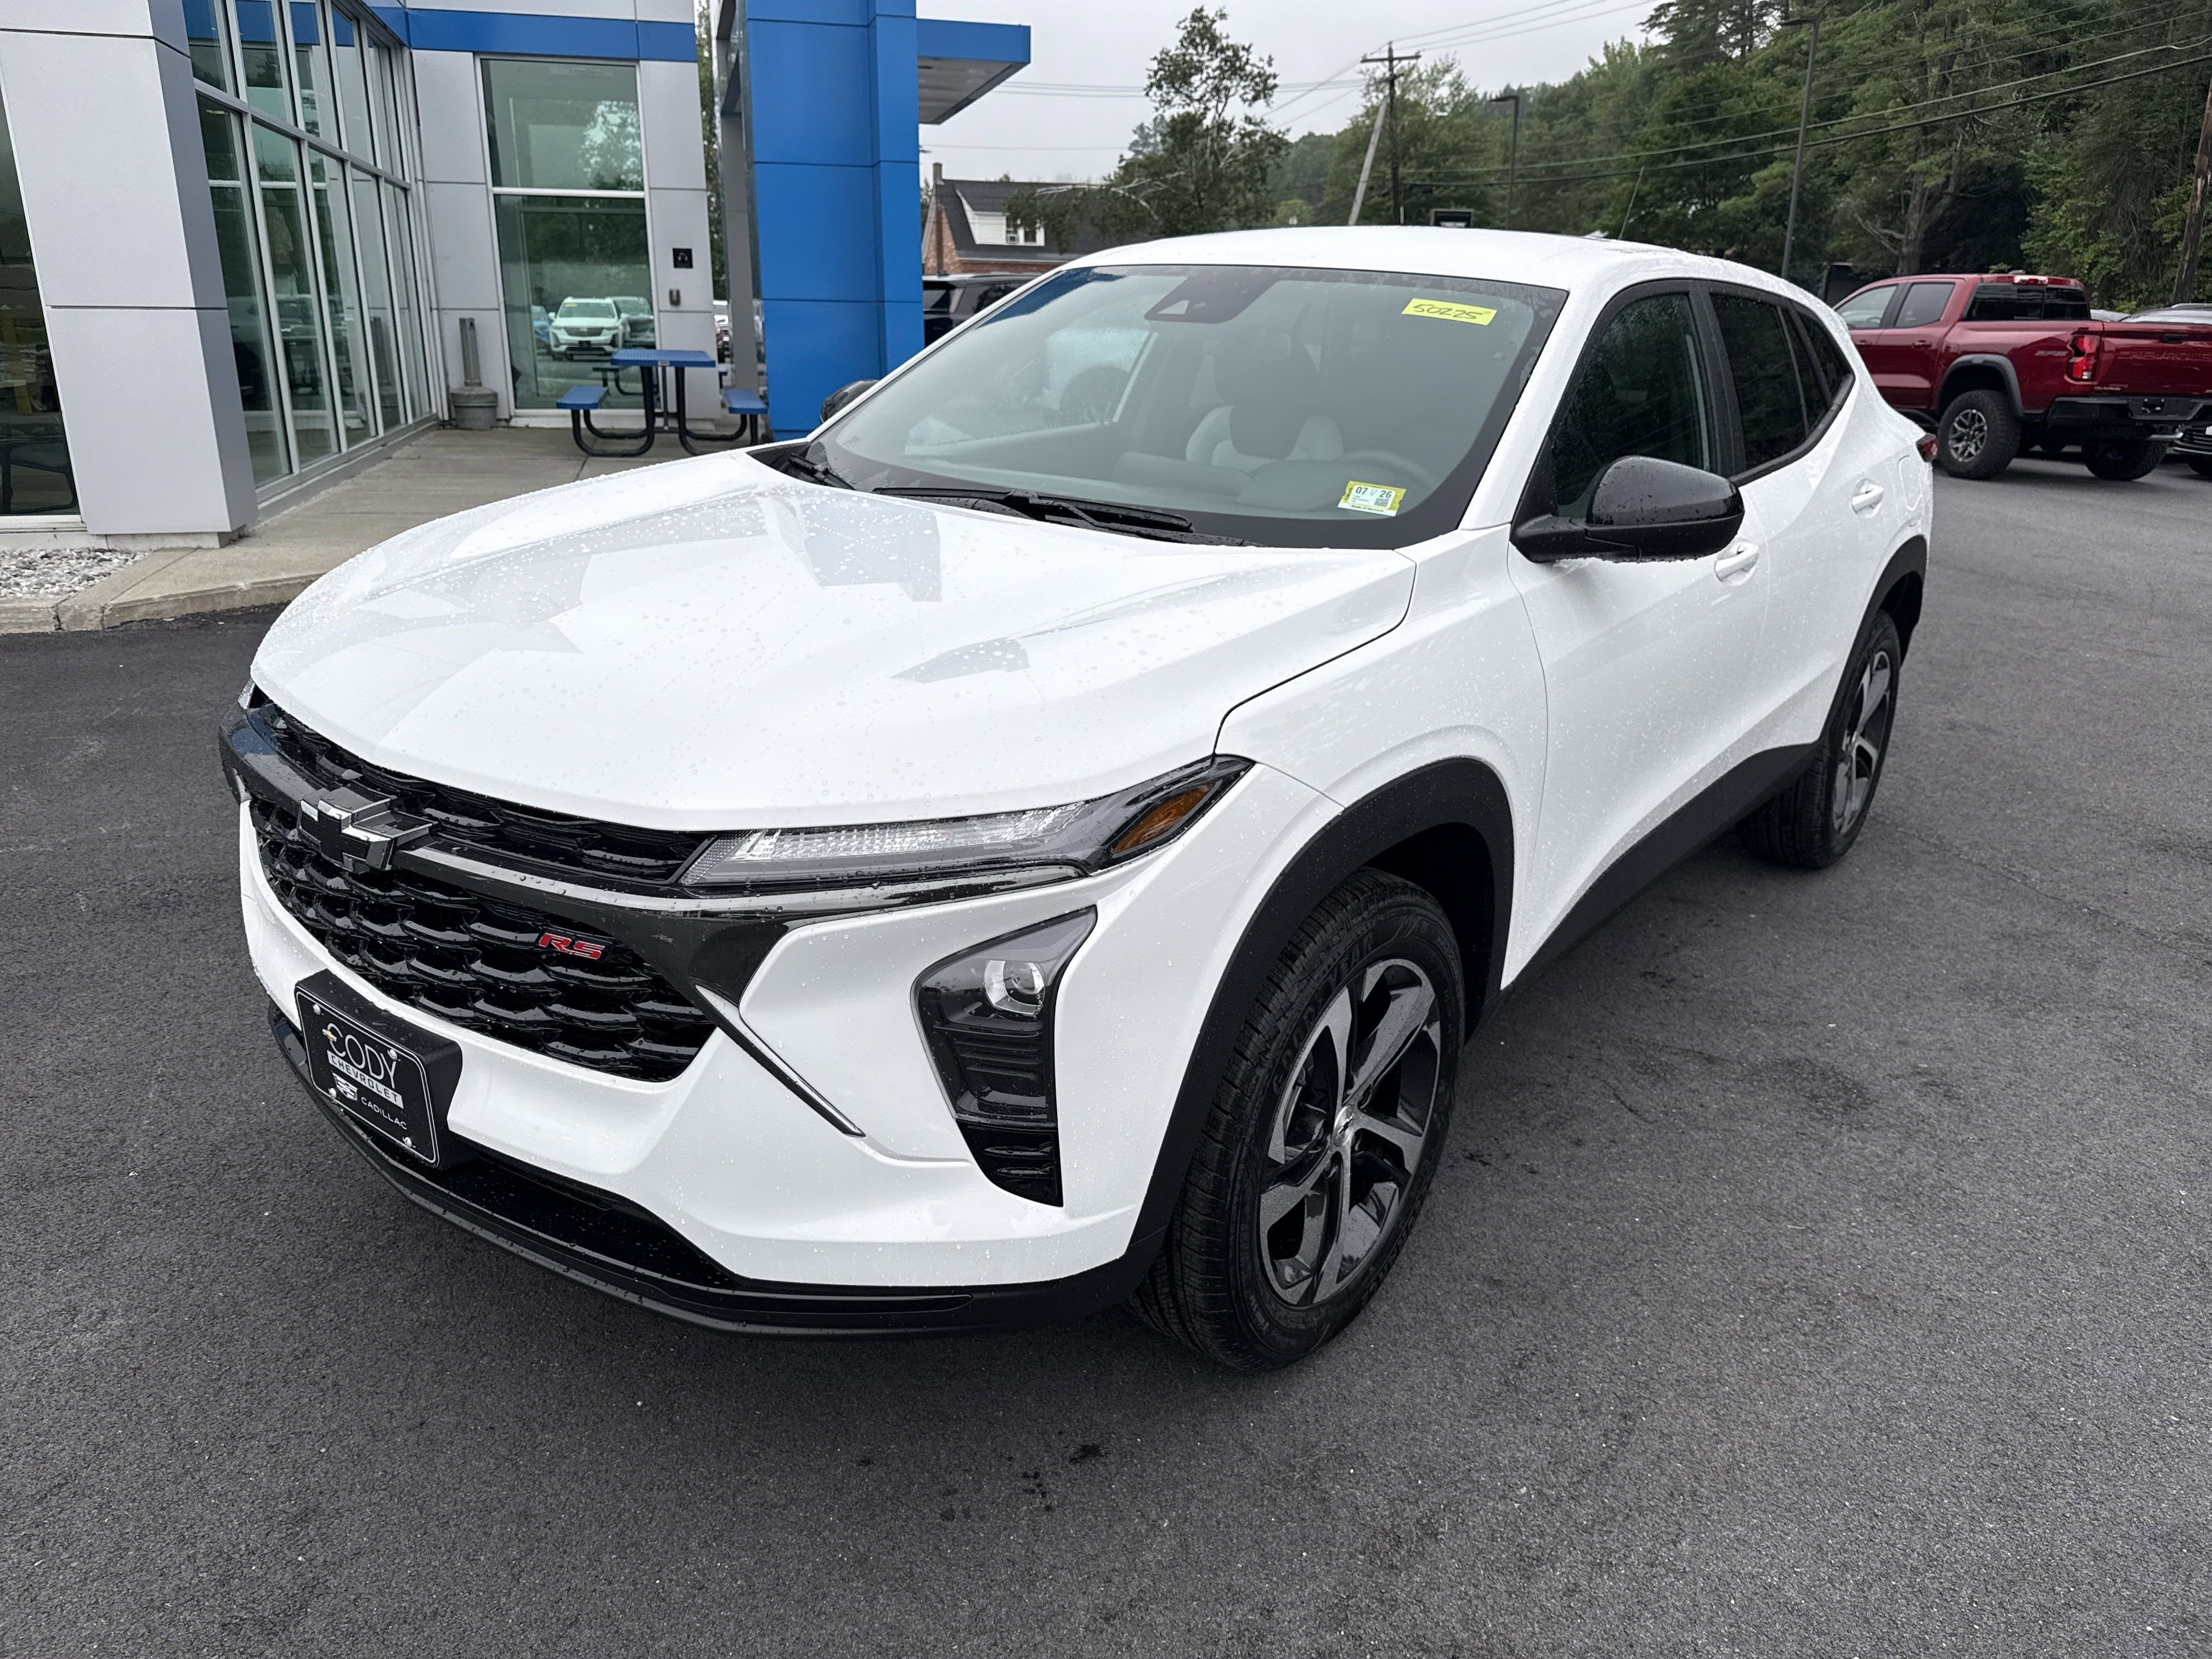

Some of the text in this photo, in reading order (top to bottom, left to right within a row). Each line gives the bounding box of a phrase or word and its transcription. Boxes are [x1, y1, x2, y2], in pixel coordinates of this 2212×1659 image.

[1356, 487, 1368, 495] 07
[1379, 490, 1392, 499] 26
[538, 933, 606, 960] RS
[327, 1023, 397, 1089] CODY
[331, 1054, 400, 1103] CHEVROLET
[360, 1097, 408, 1130] CADILLAC
